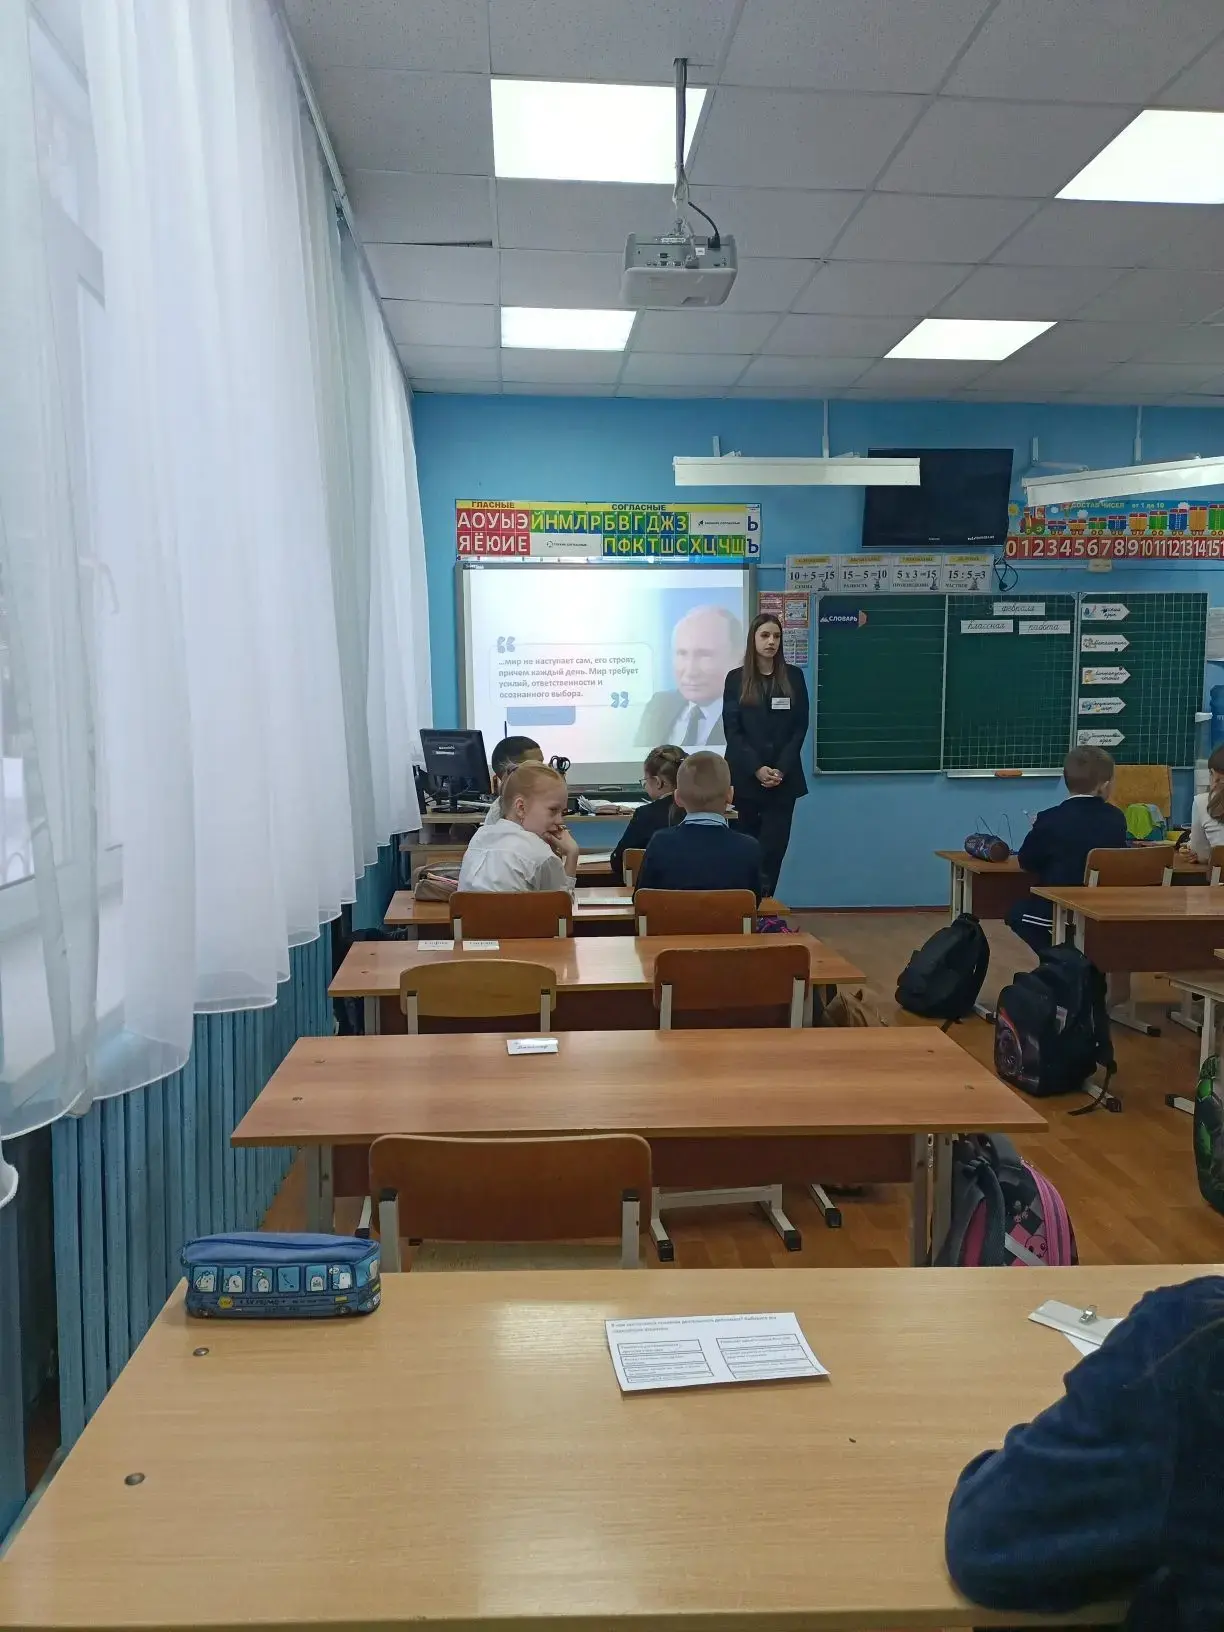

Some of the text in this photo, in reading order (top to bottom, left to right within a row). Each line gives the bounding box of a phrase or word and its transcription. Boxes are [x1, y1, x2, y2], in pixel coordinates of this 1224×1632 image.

[471, 501, 515, 509] ГЛАСНЫЕ
[611, 503, 666, 511] СОГЛАСНЫЕ
[747, 515, 759, 532] Ь
[746, 538, 759, 554] Ъ
[1006, 540, 1017, 556] 0
[1021, 540, 1028, 556] 1
[1034, 540, 1044, 556] 2
[1047, 540, 1058, 556] 3
[1060, 540, 1072, 556] 4
[1074, 540, 1085, 556] 5
[1087, 540, 1098, 556] 6
[1101, 540, 1112, 556] 7
[1114, 540, 1126, 556] 8
[1127, 540, 1140, 556] 9
[1140, 540, 1152, 556] 10
[1154, 540, 1166, 556] 11
[1167, 540, 1180, 556] 12
[1180, 540, 1193, 556] 13
[1194, 540, 1206, 556] 14
[1206, 540, 1220, 556] 15
[790, 571, 800, 580] 10
[843, 570, 853, 580] 15
[948, 570, 959, 579] 15
[523, 658, 534, 666] не
[535, 657, 574, 667] наступает
[575, 656, 593, 666] сам,
[594, 656, 607, 664] его
[608, 656, 636, 666] строят,
[530, 667, 564, 678] каждый
[565, 667, 588, 677] день.
[588, 666, 607, 677] Мир
[608, 666, 639, 676] требует
[498, 678, 603, 689] усилий, ответственности и
[499, 689, 584, 699] осознанного выбора.
